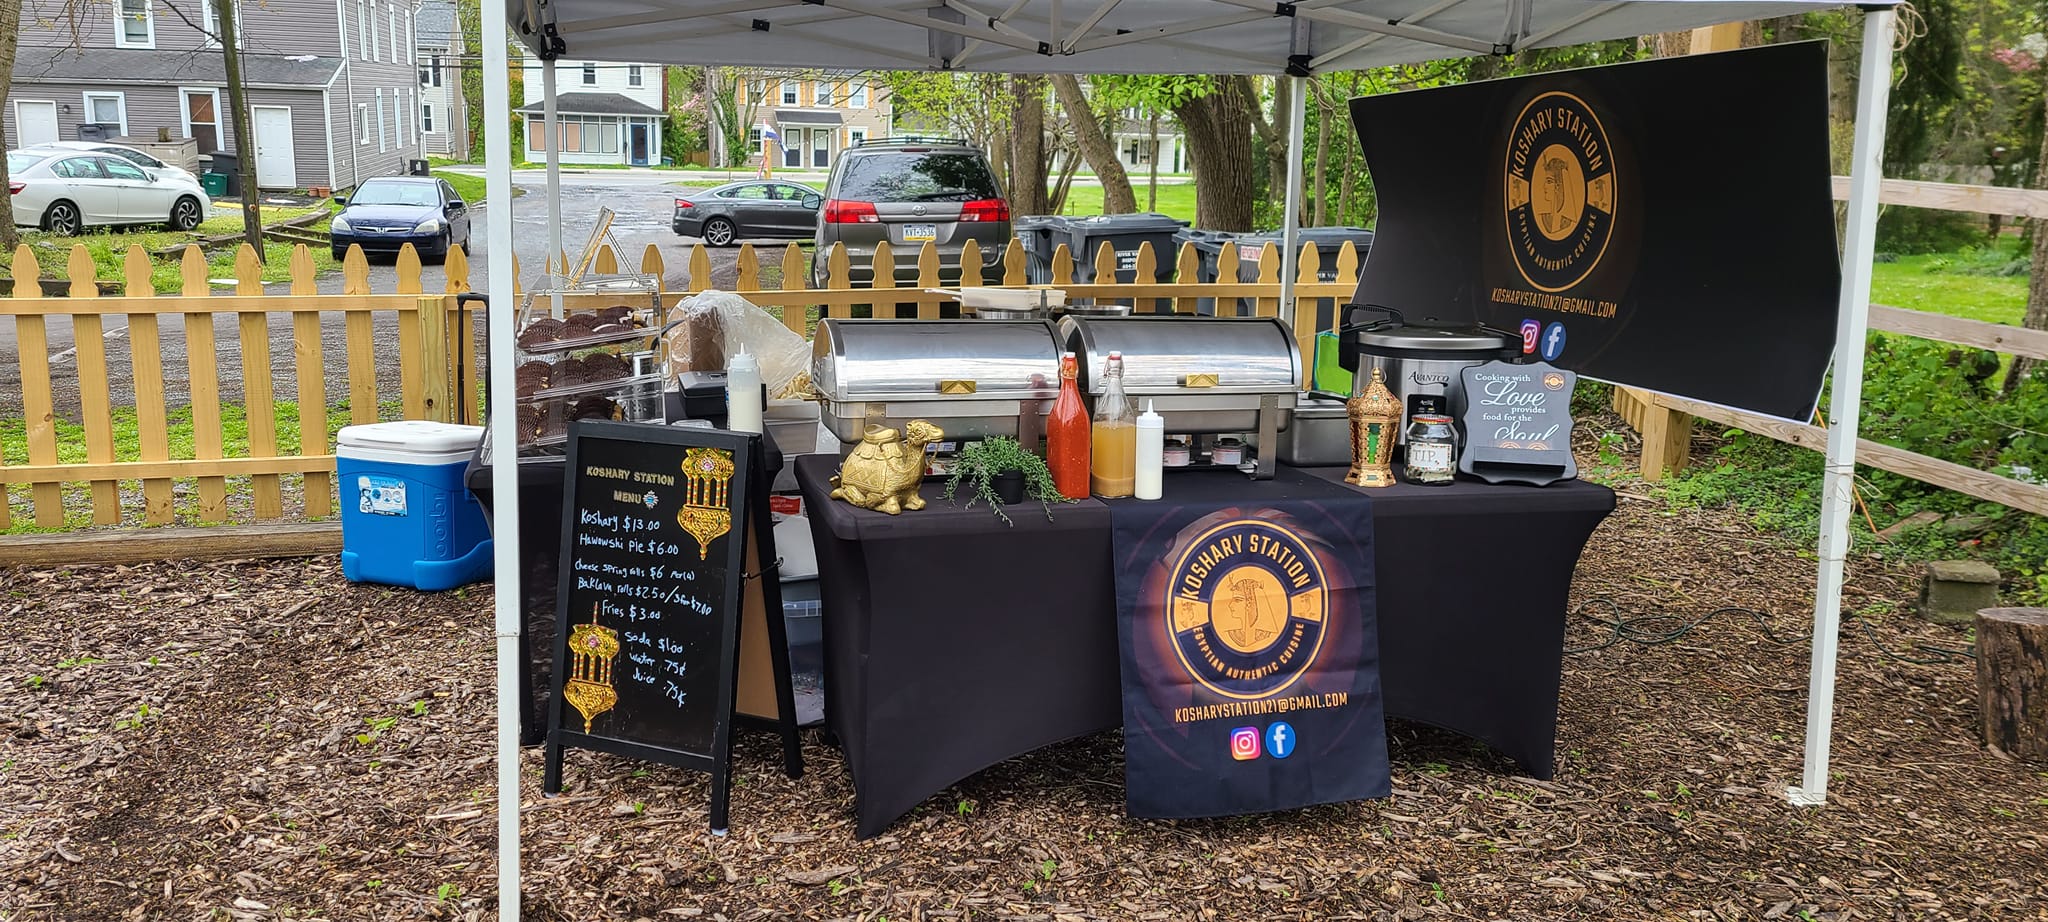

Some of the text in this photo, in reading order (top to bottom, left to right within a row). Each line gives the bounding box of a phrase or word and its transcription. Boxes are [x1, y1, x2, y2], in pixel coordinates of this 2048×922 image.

[1513, 107, 1604, 177] KOSHARY STATION
[1518, 206, 1598, 272] EGYPTIAN AUTHENTIC CUISINE
[1492, 288, 1618, 319] KOSHARYSTATION21@GMAIL.COM
[1475, 373, 1531, 383] Cooking with
[1480, 380, 1546, 406] Love
[1483, 413, 1502, 421] food
[1512, 406, 1546, 414] provides
[586, 466, 675, 486] KOSHARY STATION
[614, 490, 642, 504] MENU
[581, 509, 660, 532] Koshary $13.00
[647, 539, 679, 556] $6.00
[650, 565, 664, 580] $6
[1181, 534, 1310, 600] KOSHARY STATION
[602, 599, 660, 622] Fries $3.00
[1192, 622, 1305, 682] EGYPTIAN AUTHENTIC CUISINE
[1175, 692, 1348, 724] KOSHARYSTATION21@GMAIL.COM
